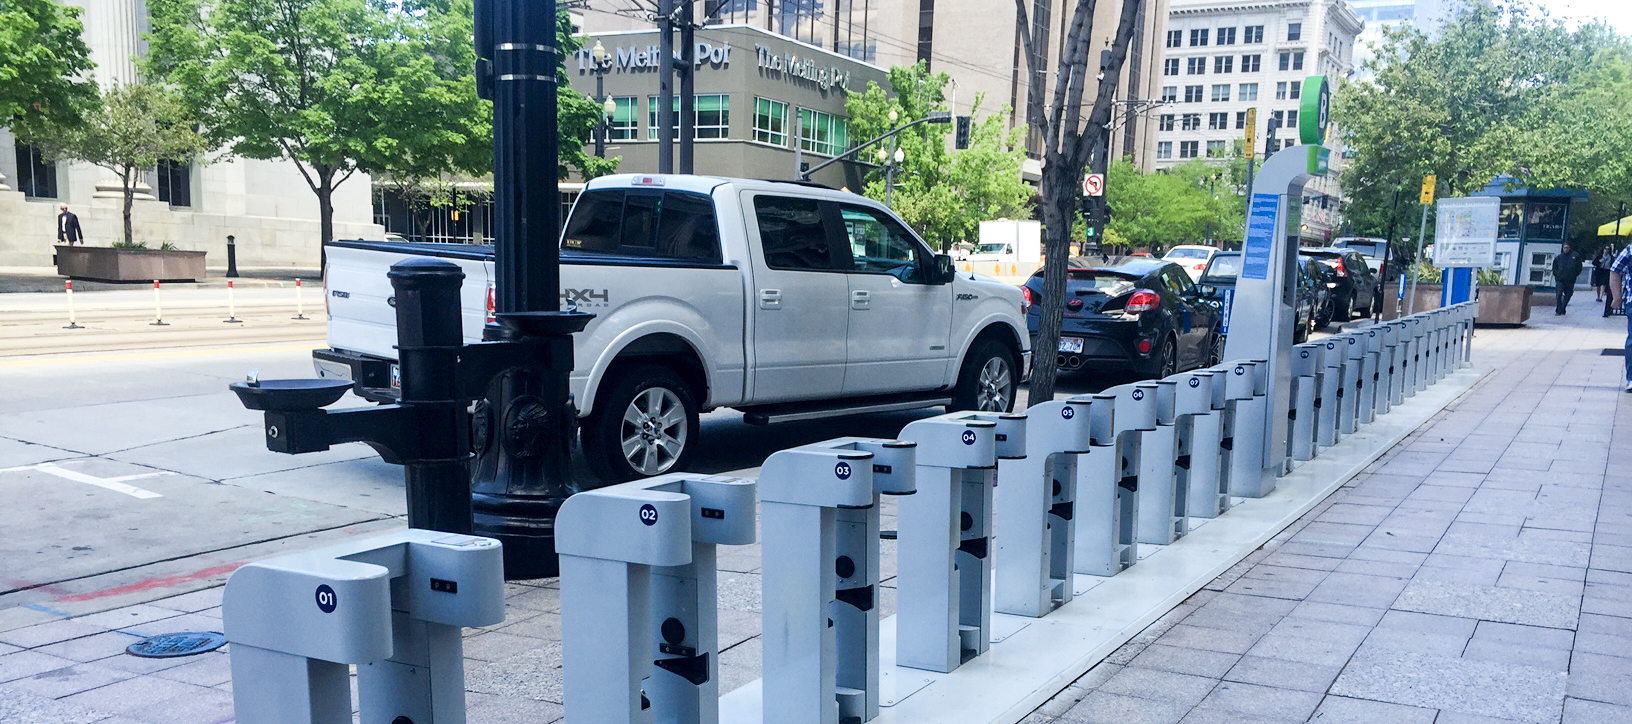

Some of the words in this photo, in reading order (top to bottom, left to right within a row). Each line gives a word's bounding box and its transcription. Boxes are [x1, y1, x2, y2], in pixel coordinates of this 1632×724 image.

[694, 41, 731, 65] Pot
[755, 43, 781, 70] The
[1319, 92, 1327, 129] B
[1087, 228, 1094, 236] 3
[963, 434, 974, 442] 04
[836, 466, 849, 476] 03
[641, 509, 656, 520] 02
[319, 591, 333, 606] 01
